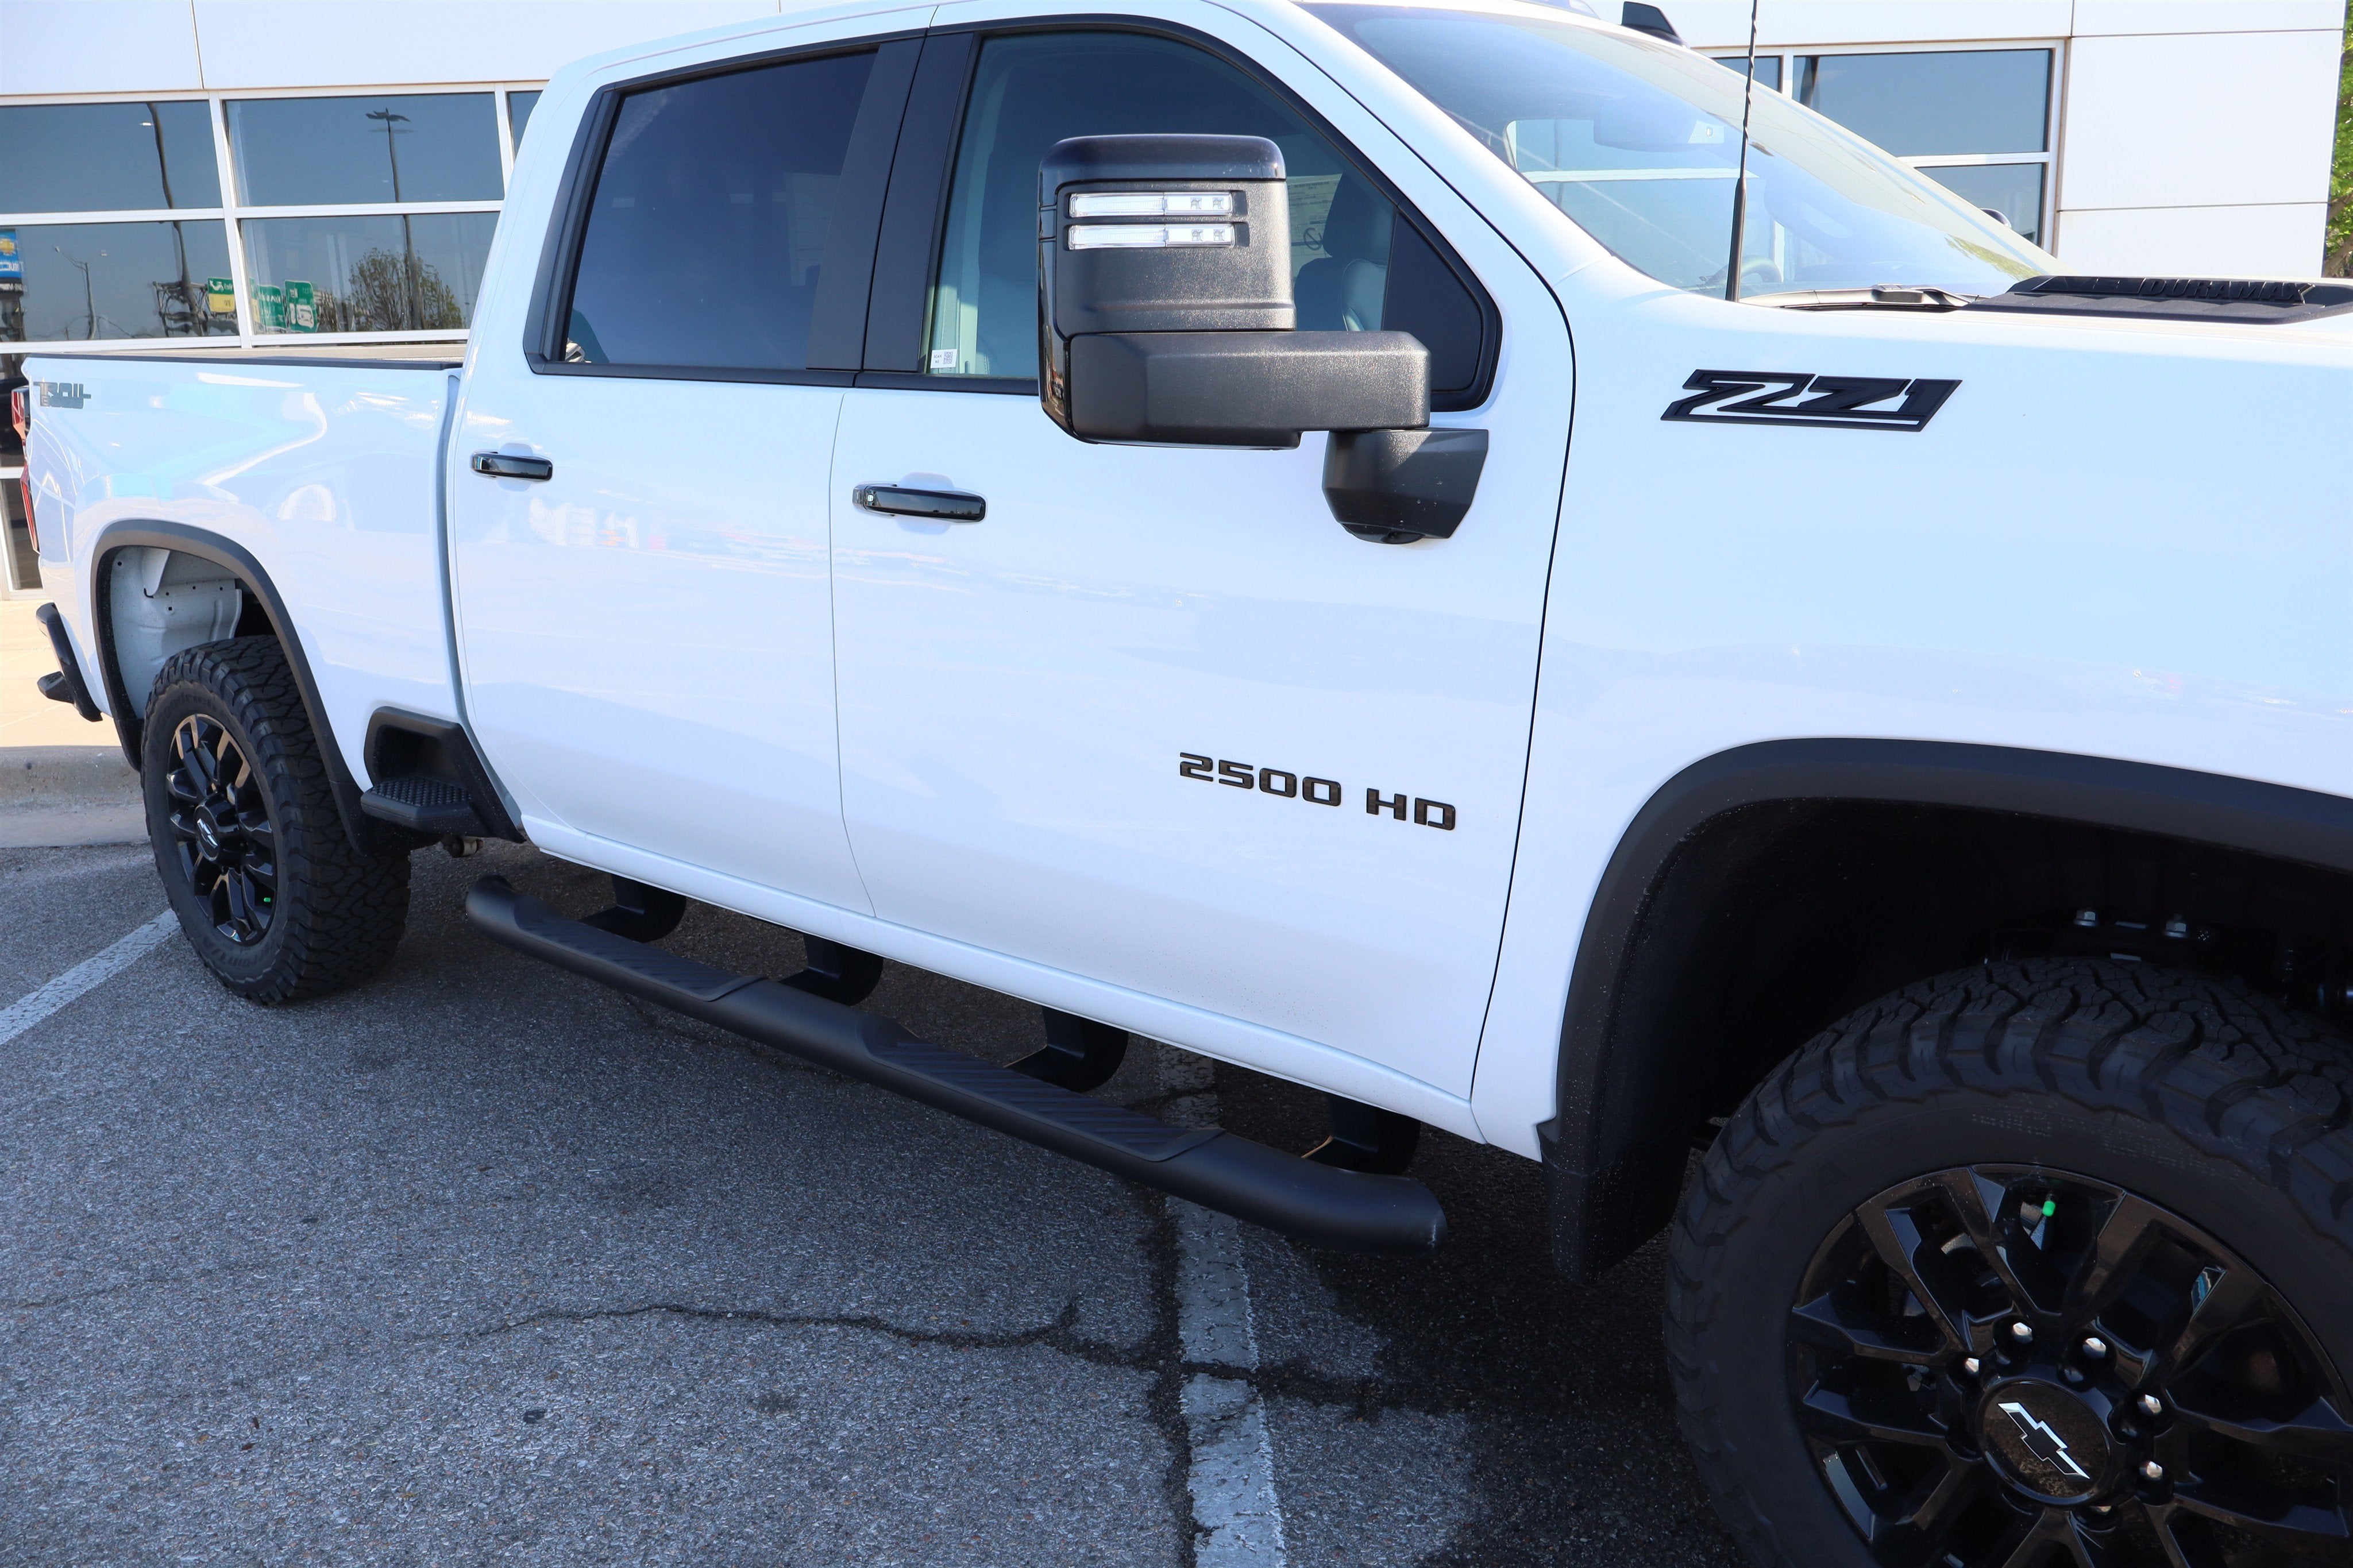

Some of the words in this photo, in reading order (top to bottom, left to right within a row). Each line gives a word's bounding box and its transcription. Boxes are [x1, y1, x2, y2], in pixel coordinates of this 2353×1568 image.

[2140, 277, 2312, 303] DURAMAX
[33, 381, 92, 399] TRAIL
[1660, 369, 1963, 432] Z71
[1179, 751, 1342, 807] 2500
[1366, 787, 1456, 831] HD
